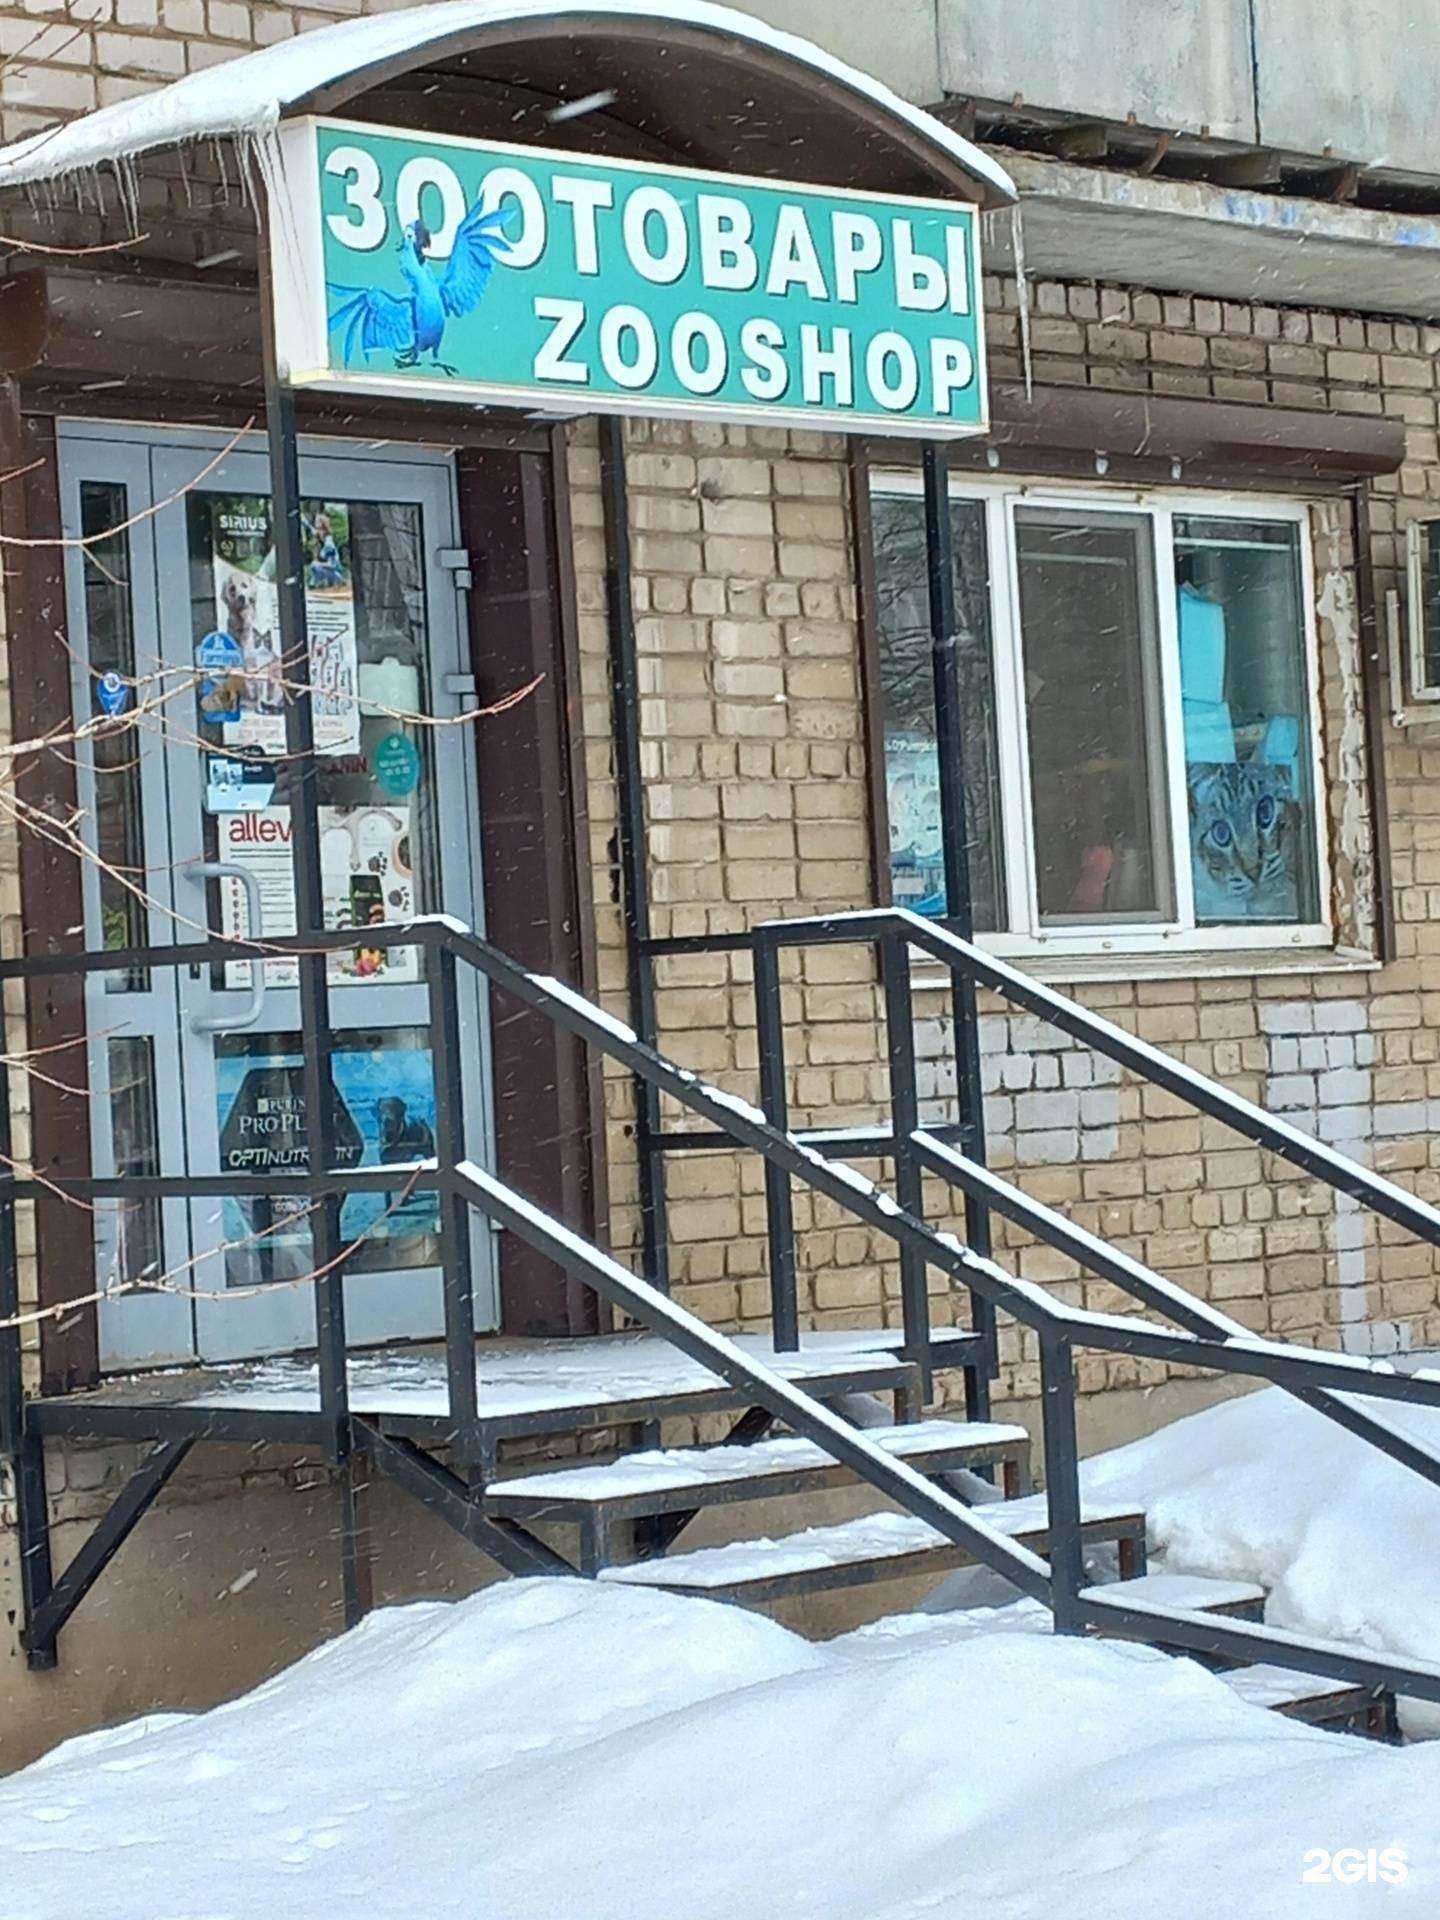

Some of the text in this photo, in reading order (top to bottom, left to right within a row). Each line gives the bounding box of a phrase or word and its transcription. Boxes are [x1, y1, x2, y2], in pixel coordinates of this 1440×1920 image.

[323, 145, 971, 317] ЗООТОВАРЫ
[533, 296, 976, 416] ZOOSHOP
[228, 812, 293, 843] allev
